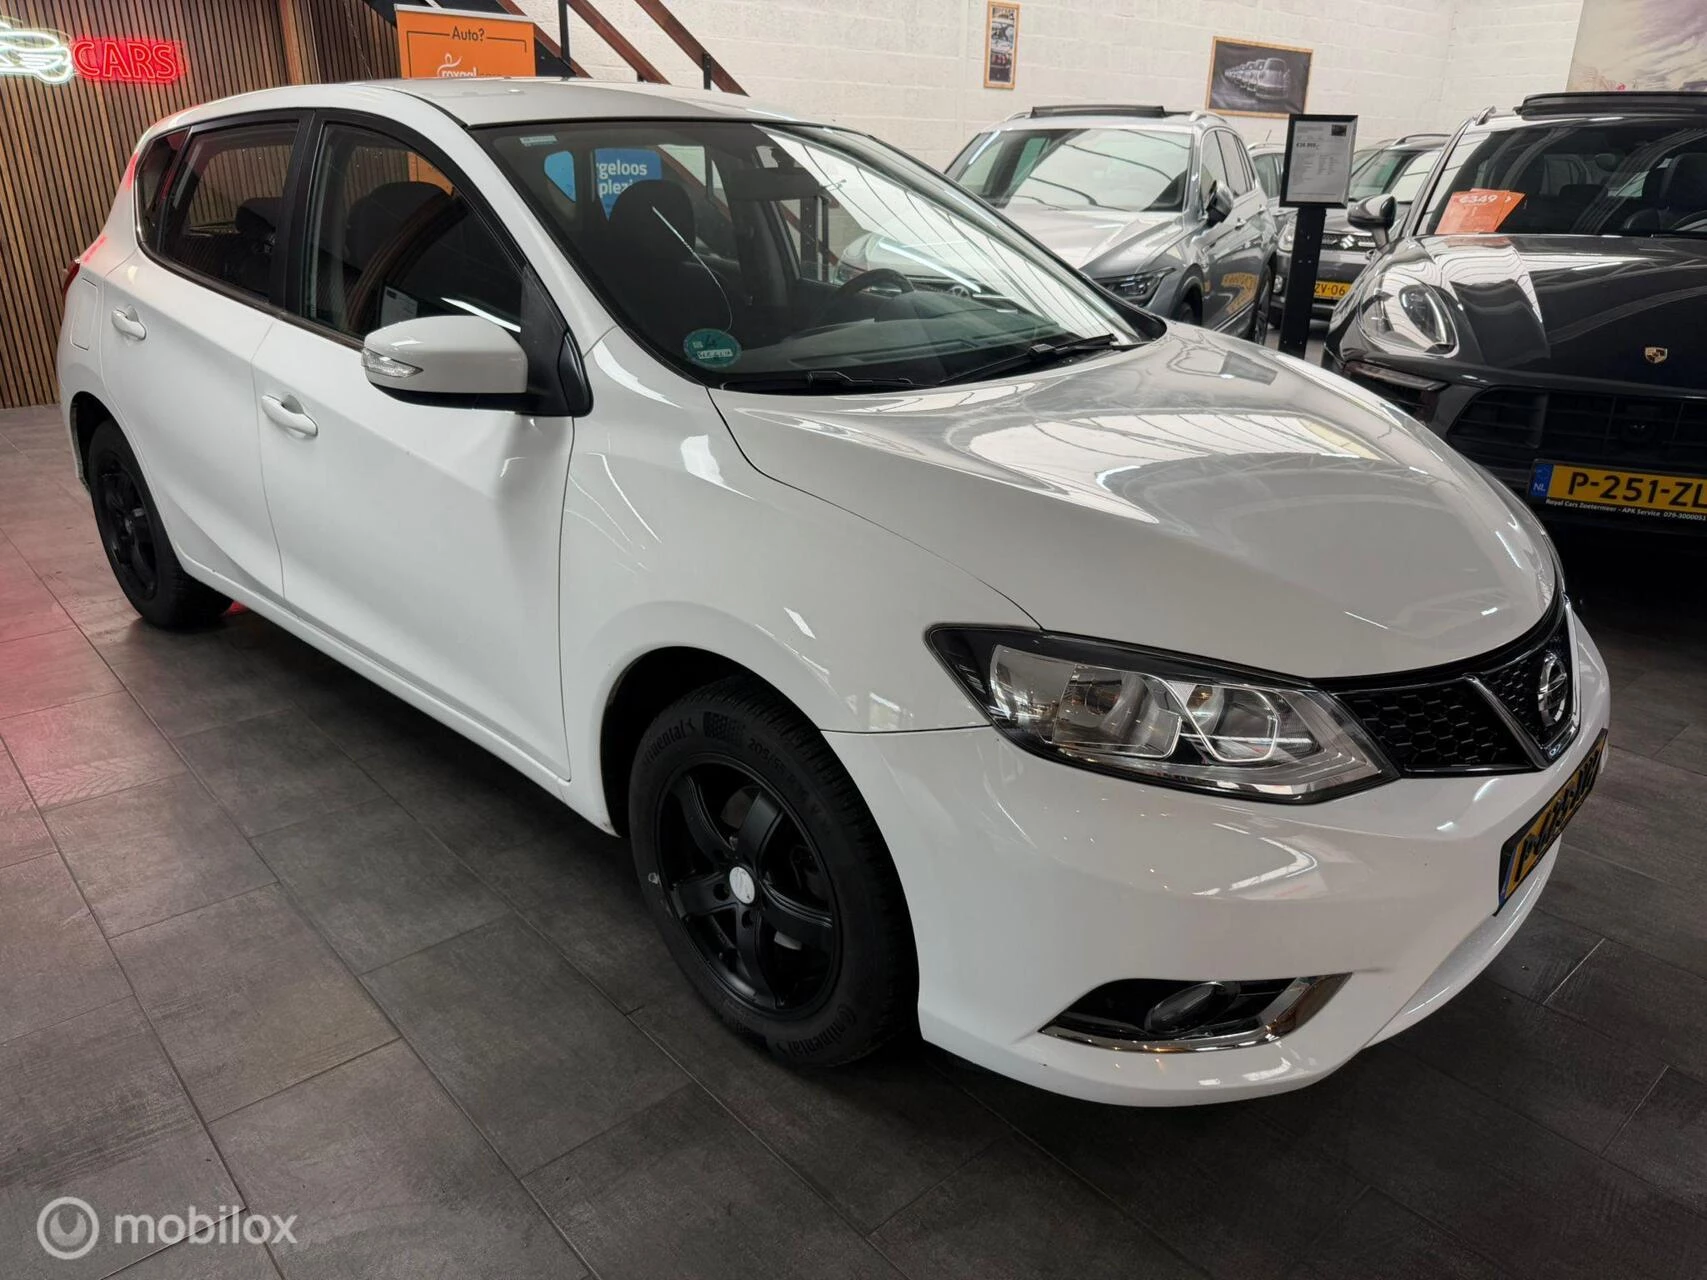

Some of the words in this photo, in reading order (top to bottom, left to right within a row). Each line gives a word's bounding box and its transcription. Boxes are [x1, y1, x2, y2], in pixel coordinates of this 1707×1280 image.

[452, 26, 485, 42] Auto?
[72, 41, 177, 79] CARS
[1533, 482, 1546, 492] NL
[1568, 472, 1707, 508] P-251-ZL
[1545, 499, 1564, 507] Royal
[1579, 503, 1617, 512] Zoetermeer
[1637, 509, 1661, 517] Service
